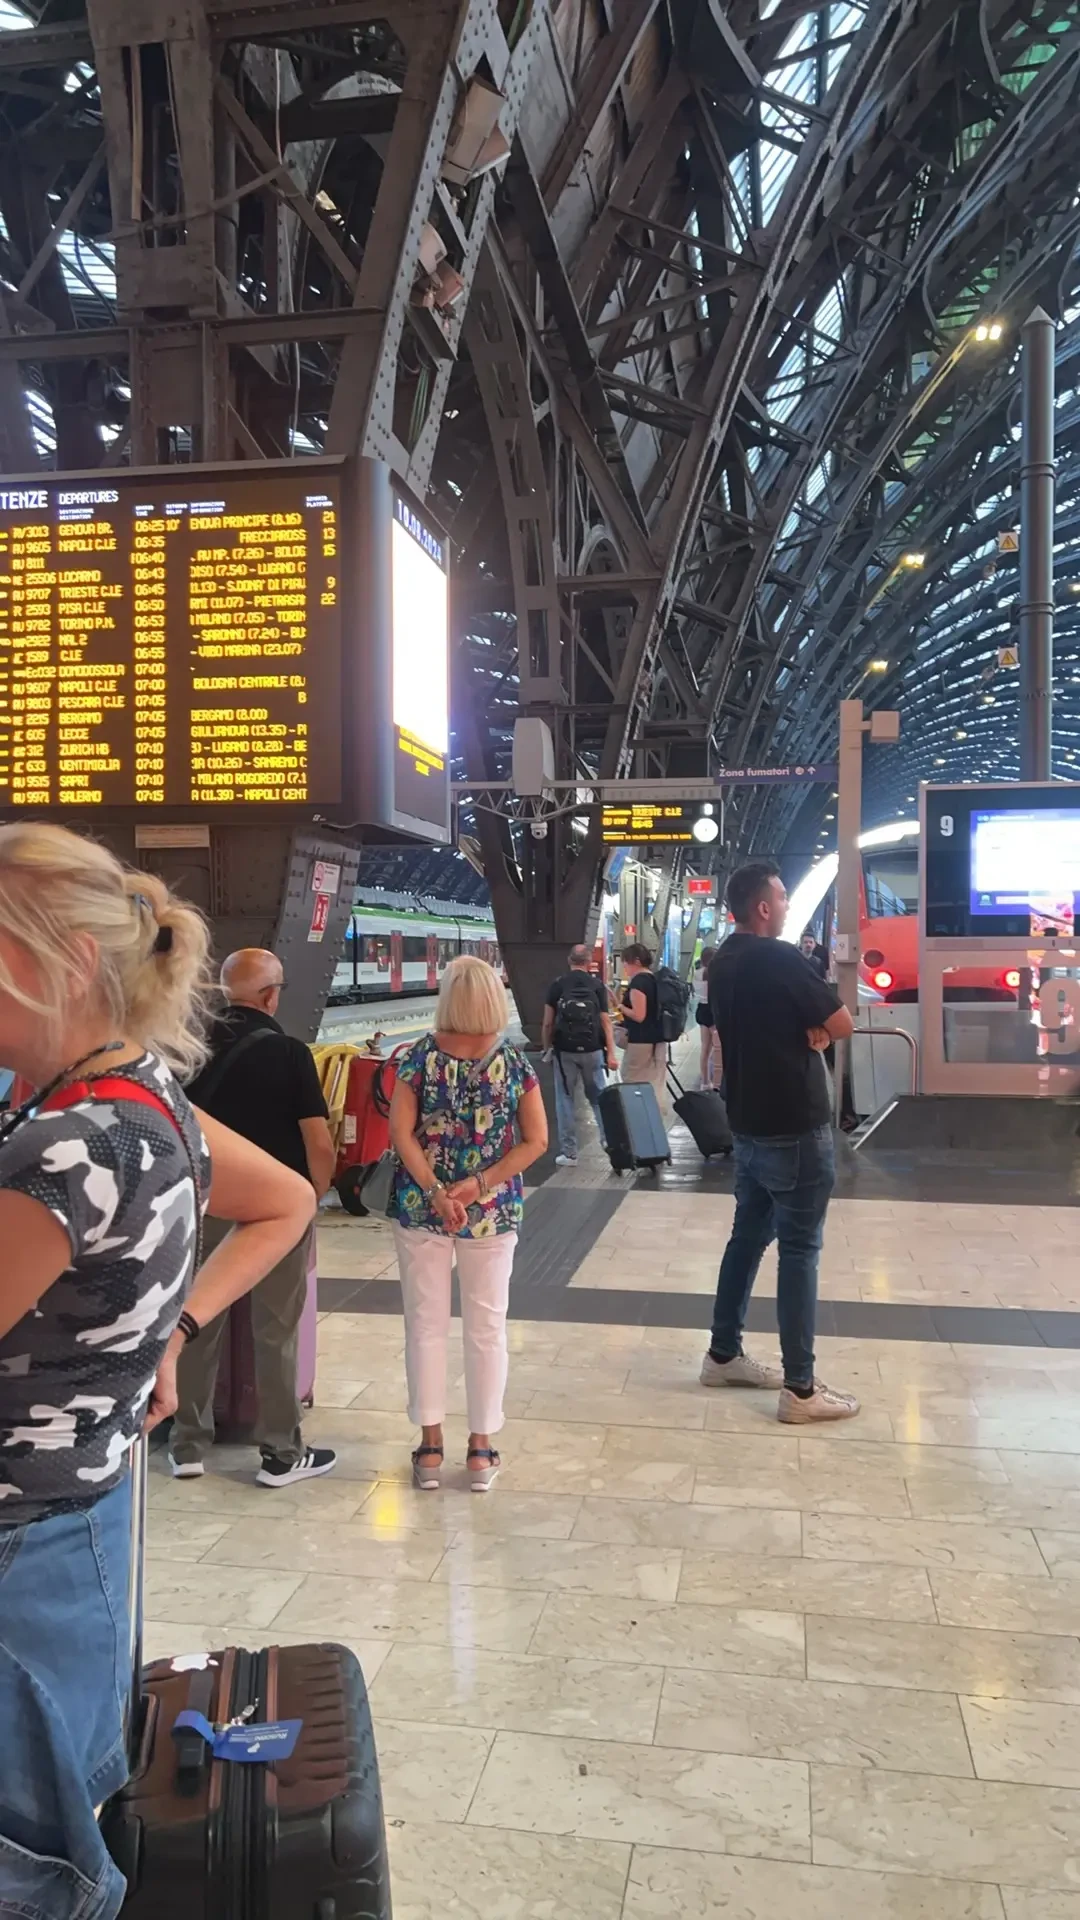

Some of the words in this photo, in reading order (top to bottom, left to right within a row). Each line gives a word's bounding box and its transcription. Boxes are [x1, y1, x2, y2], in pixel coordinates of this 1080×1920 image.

[58, 490, 119, 505] DEPARTURES
[222, 514, 270, 528] PRINCIPE
[322, 511, 335, 523] 21
[135, 519, 165, 532] 06:25
[397, 498, 442, 565] 10.08.2024
[323, 528, 336, 540] 13
[58, 539, 93, 552] NAPOLI
[135, 536, 166, 548] 06:35
[323, 544, 336, 556] 15
[135, 551, 165, 564] 06:40
[135, 567, 165, 580] 06:43
[257, 562, 295, 576] LUGANO
[58, 570, 101, 583] LOCARNO
[327, 576, 336, 589] 9
[25, 588, 51, 600] 9707
[59, 586, 99, 598] TRIESTE
[134, 583, 166, 596] 06:45
[320, 593, 336, 605] 22
[58, 602, 82, 614] PISA
[134, 599, 165, 612] 06:50
[59, 618, 94, 630] TORINO
[134, 615, 165, 627] 06:53
[195, 612, 231, 625] MILANO
[134, 631, 165, 643] 06:55
[201, 628, 246, 641] SARONNO
[134, 647, 166, 659] 06:55
[225, 644, 262, 656] MARINA
[263, 643, 302, 656] (23.07)
[58, 664, 125, 677] DOMODOSSOLA
[135, 663, 165, 675] 07:00
[58, 680, 93, 693] NAPOLI
[135, 679, 165, 691] 07:00
[193, 676, 237, 690] BOLOGNA
[239, 675, 288, 689] CENTRALE
[59, 696, 102, 708] PESCARA
[135, 695, 166, 707] 07:05
[59, 712, 102, 725] BERGAMO
[135, 711, 166, 723] 07:05
[190, 709, 234, 722] BERGAMO
[59, 728, 89, 740] LECCE
[136, 727, 166, 739] 07:05
[59, 743, 94, 756] ZURICH
[136, 742, 164, 755] 07:10
[212, 741, 250, 753] LUGANO
[59, 759, 120, 772] VENTIMIGLIA
[136, 758, 164, 771] 07:10
[253, 756, 298, 768] SANREMO
[719, 768, 744, 777] Zona
[747, 767, 789, 777] fumatori
[59, 775, 89, 787] SAPRI
[136, 774, 164, 786] 07:10
[197, 773, 233, 785] MILANO
[235, 773, 285, 785] ROGOREDO
[59, 790, 102, 803] SALERNO
[136, 790, 164, 802] 07:15
[244, 788, 280, 800] NAPOLI
[940, 815, 954, 837] 9
